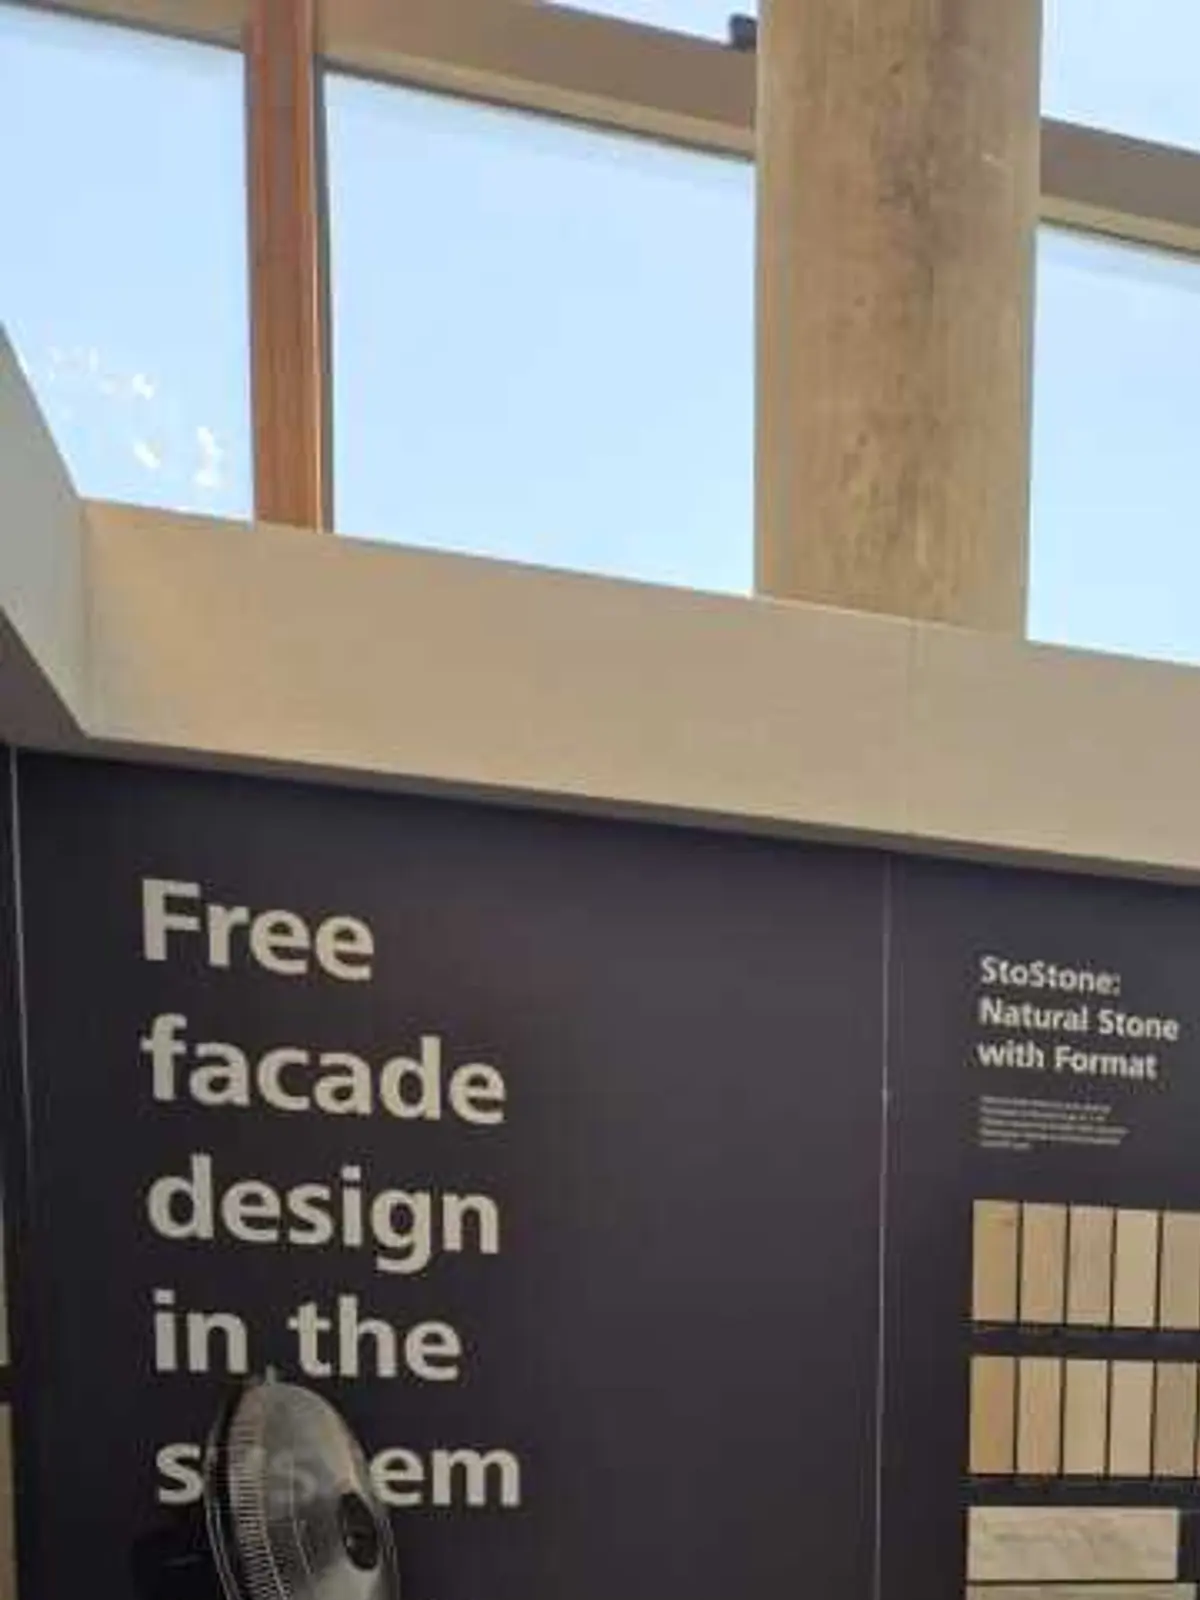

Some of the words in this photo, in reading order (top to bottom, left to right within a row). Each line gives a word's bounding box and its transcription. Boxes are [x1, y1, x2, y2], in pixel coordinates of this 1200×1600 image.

[142, 878, 375, 981] Free
[979, 955, 1122, 996] StoStone:
[976, 1038, 1046, 1069] with
[1053, 1045, 1159, 1080] Format
[978, 996, 1090, 1032] Natural
[1096, 1008, 1181, 1042] Stone
[140, 1013, 507, 1125] facade
[146, 1153, 500, 1274] design
[152, 1289, 249, 1374] in
[287, 1294, 462, 1381] the
